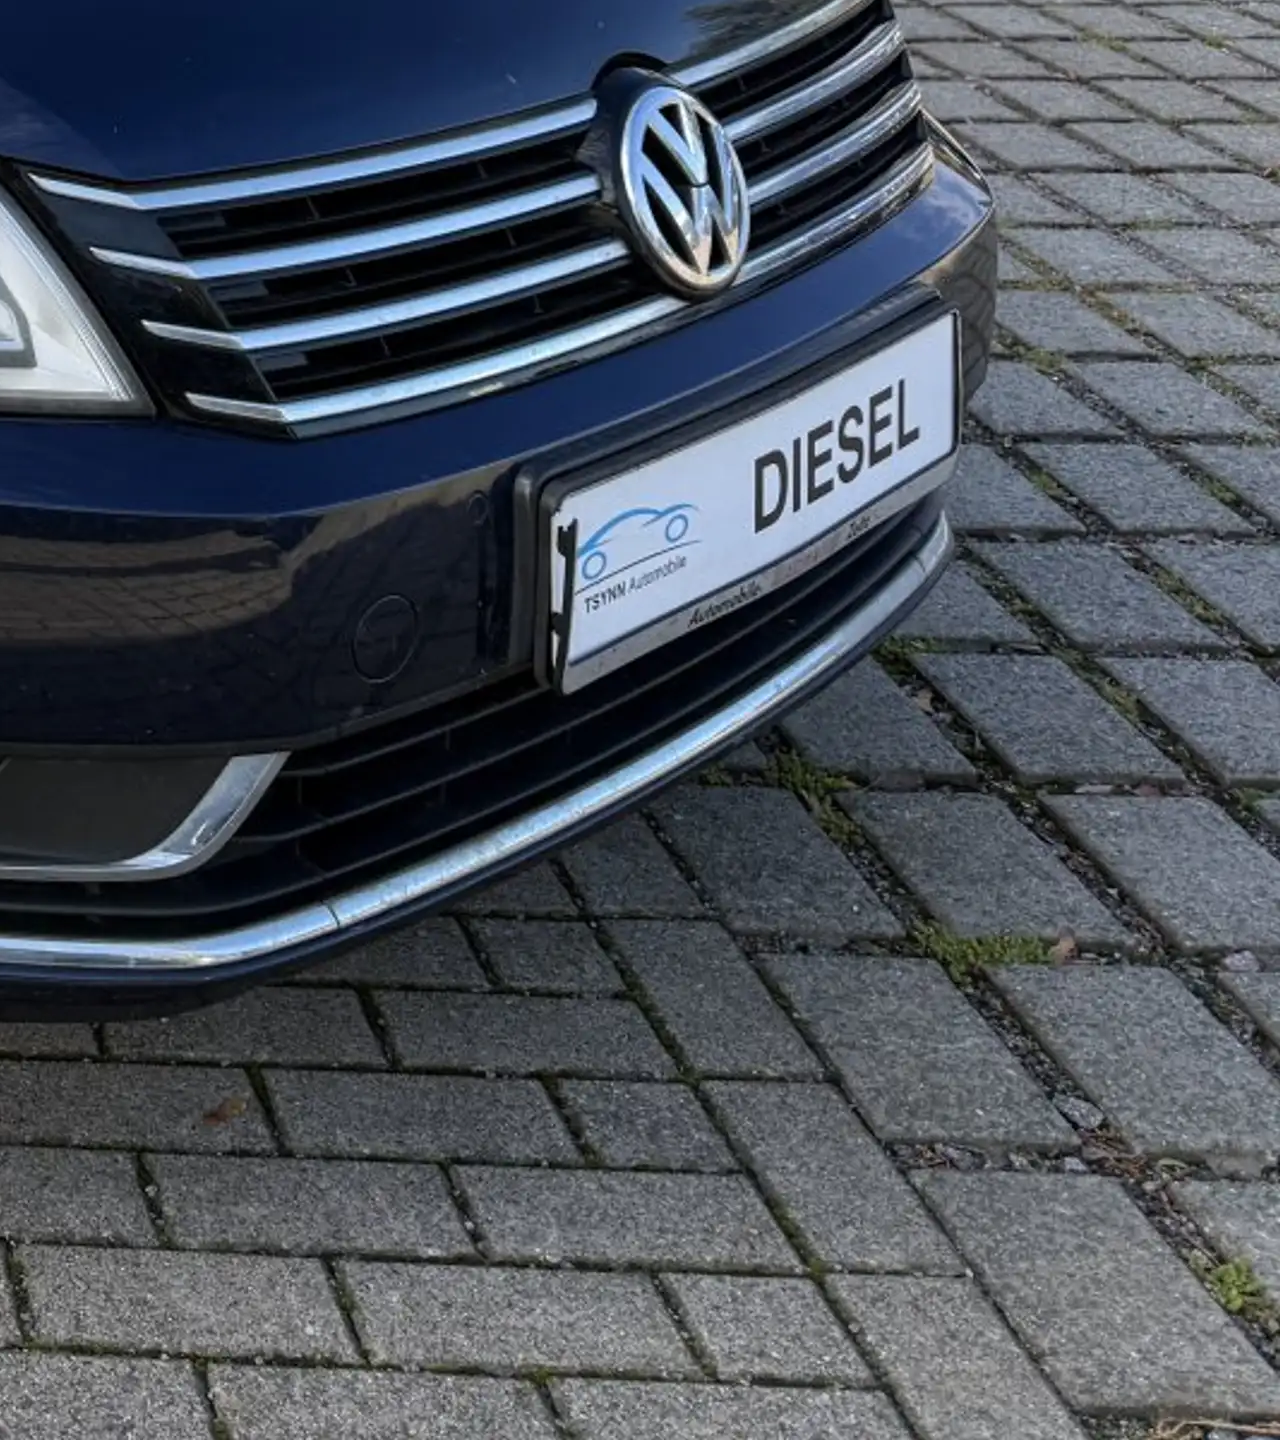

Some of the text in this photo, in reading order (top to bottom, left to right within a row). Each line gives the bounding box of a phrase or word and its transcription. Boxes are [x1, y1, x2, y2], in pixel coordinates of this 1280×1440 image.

[753, 378, 920, 534] DIESEL
[584, 555, 687, 614] TSYNN Automobile
